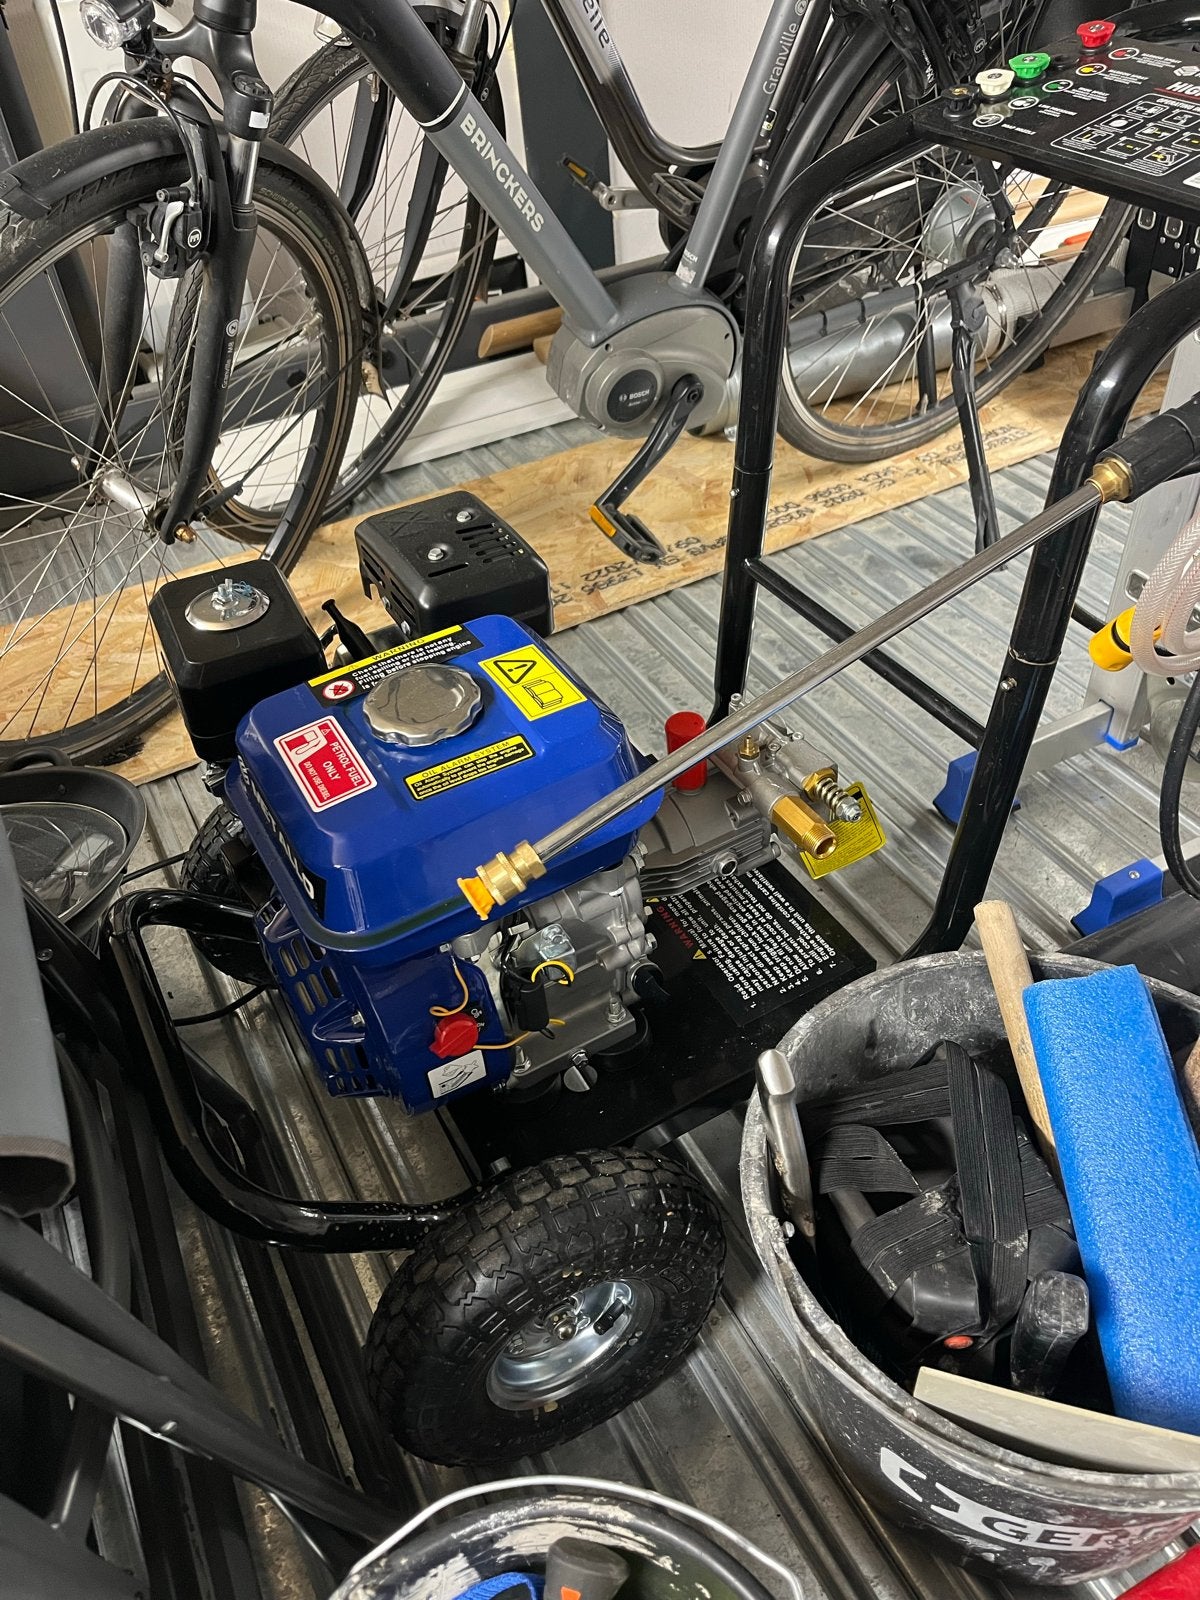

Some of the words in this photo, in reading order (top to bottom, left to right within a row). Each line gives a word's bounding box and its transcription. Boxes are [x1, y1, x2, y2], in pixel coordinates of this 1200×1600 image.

[763, 23, 799, 95] Granville
[1166, 81, 1200, 97] HIG
[460, 113, 545, 232] BRINCKERS
[629, 389, 650, 400] BOSCH
[371, 638, 425, 660] WARNING
[350, 663, 378, 677] Check
[376, 657, 395, 667] that
[357, 671, 386, 686] Filling
[384, 660, 412, 674] before
[444, 638, 472, 652] engine
[302, 760, 313, 769] DO
[328, 741, 353, 768] PETROL
[344, 766, 364, 786] FUEL
[420, 768, 438, 778] OIL
[438, 755, 472, 771] ALARM
[473, 740, 510, 758] SYSTEM
[306, 766, 318, 777] NOT
[320, 759, 342, 781] ONLY
[311, 774, 323, 785] USE
[315, 783, 331, 800] DIESEL
[705, 879, 718, 892] whe
[723, 879, 745, 900] minutes
[749, 877, 770, 896] carbon
[668, 894, 684, 910] instr
[677, 892, 698, 914] propert
[714, 889, 738, 914] engaged
[722, 888, 746, 913] enclosed
[740, 887, 758, 903] touch
[771, 890, 786, 903] well
[666, 902, 681, 917] more
[679, 907, 689, 917] all
[745, 903, 761, 917] least
[754, 902, 767, 913] not
[765, 894, 791, 919] contains
[786, 905, 796, 913] in
[678, 917, 689, 927] for
[734, 911, 748, 924] gun
[744, 911, 753, 920] an
[749, 918, 758, 926] in
[762, 911, 773, 920] do
[791, 911, 806, 923] unit
[655, 904, 695, 949] WARNING
[685, 915, 703, 933] follow
[707, 928, 716, 936] to
[710, 921, 729, 940] death.
[725, 913, 750, 938] children.
[727, 928, 736, 936] at
[744, 922, 753, 931] on
[754, 924, 769, 938] tank
[762, 922, 778, 936] cool
[787, 917, 812, 940] exhaust
[801, 922, 816, 934] this
[687, 927, 707, 949] Manual
[699, 931, 709, 939] to
[726, 938, 735, 946] or
[733, 933, 751, 951] spray
[749, 930, 764, 944] lock
[773, 934, 783, 942] to
[794, 935, 811, 950] cool.
[705, 937, 725, 958] Failure
[713, 935, 737, 959] damage
[745, 936, 761, 952] from
[760, 941, 783, 963] trigger
[778, 940, 794, 954] unit
[785, 936, 810, 959] prevent
[806, 938, 831, 960] Engine
[812, 933, 838, 957] Operate
[730, 944, 750, 963] injury
[745, 950, 765, 969] direct
[758, 949, 776, 966] away
[781, 954, 795, 966] not
[807, 949, 824, 963] until
[710, 954, 737, 982] Operator
[721, 956, 742, 977] using.
[734, 958, 752, 977] cause
[777, 960, 796, 978] Keep
[790, 953, 810, 971] Allow
[790, 964, 802, 974] Do
[805, 958, 817, 967] To
[826, 960, 837, 968] 7.
[745, 961, 773, 989] personal
[760, 967, 780, 986] Never
[770, 964, 789, 982] Keep
[799, 974, 810, 982] 5.
[813, 967, 824, 975] 6.
[736, 975, 757, 996] before
[750, 977, 766, 992] may
[777, 986, 787, 994] 2.
[785, 982, 795, 990] 3.
[792, 978, 802, 986] 4.
[732, 982, 750, 1000] Read
[747, 1000, 758, 1009] 1.
